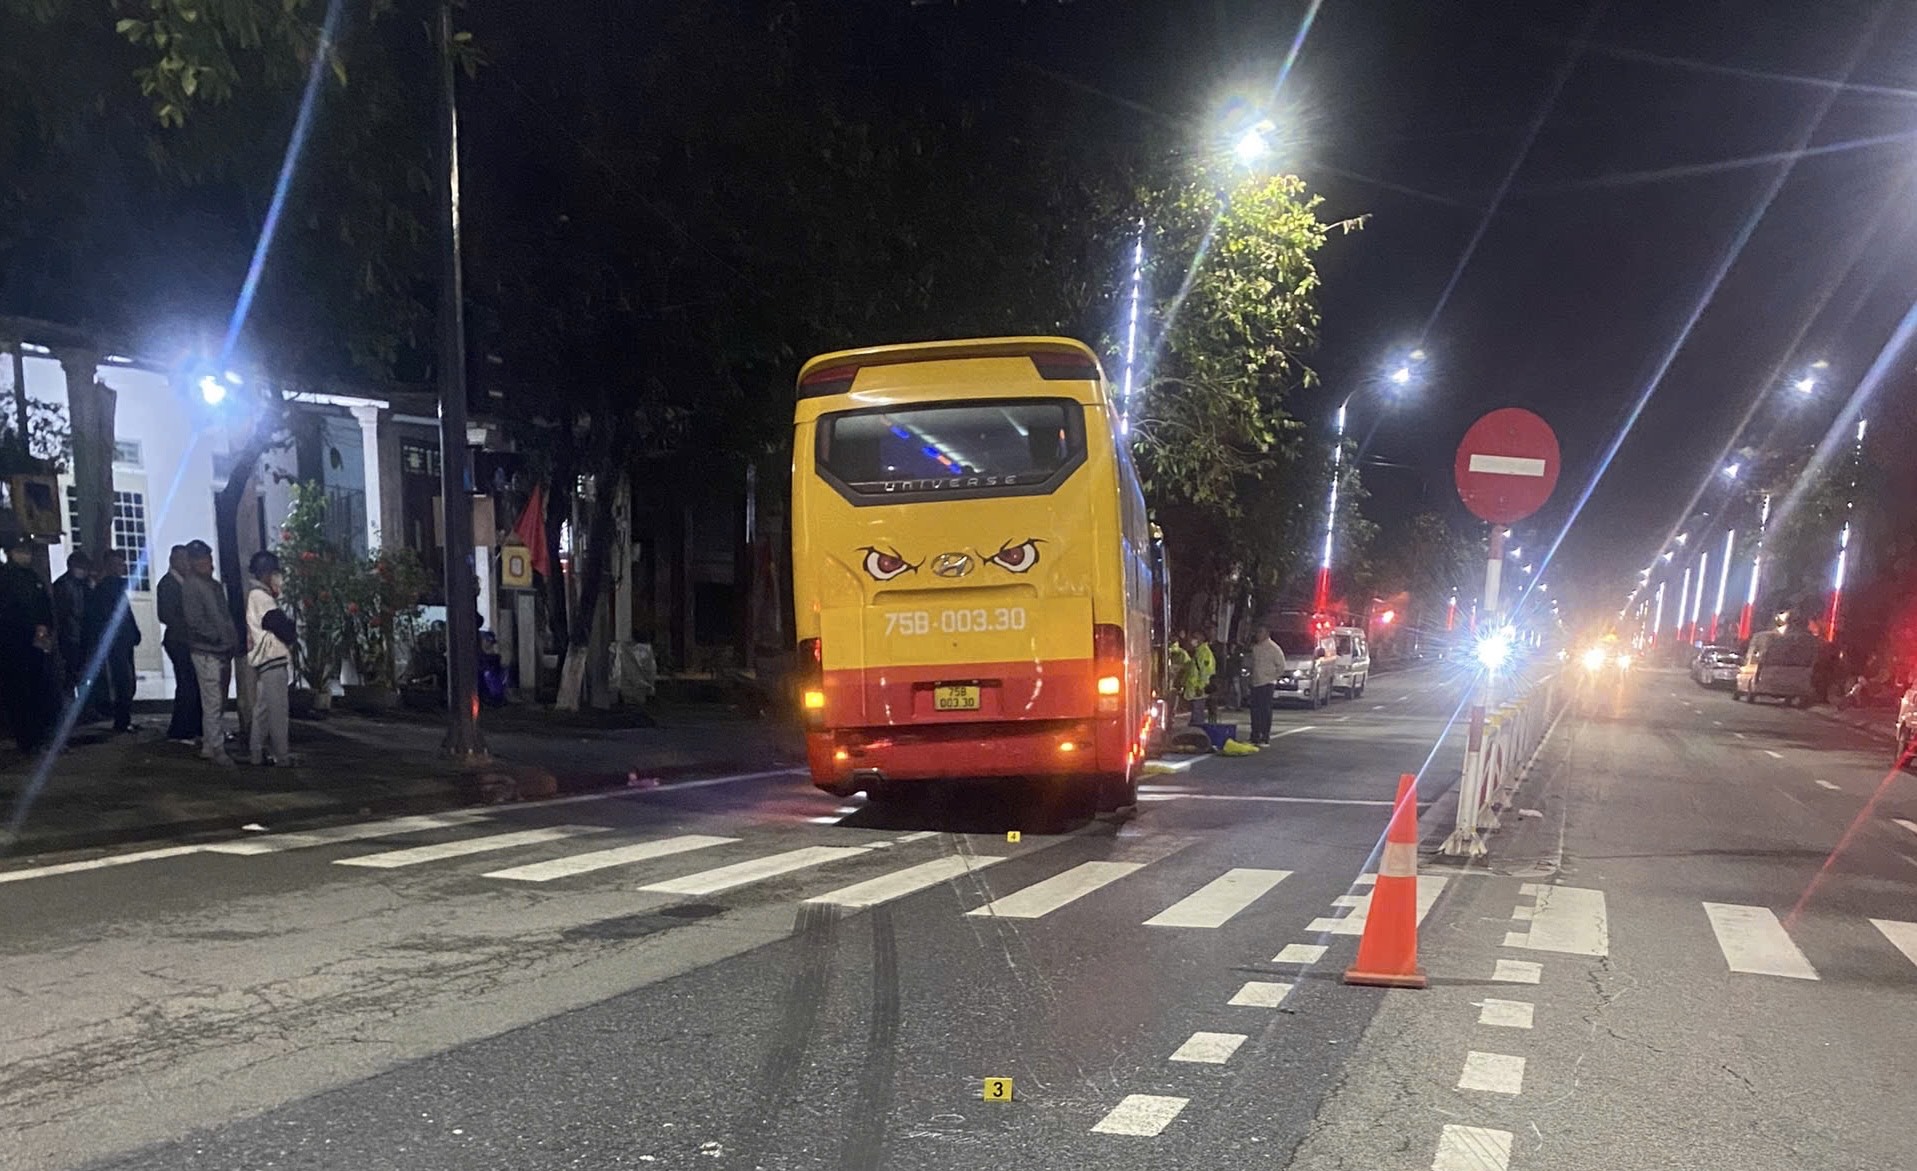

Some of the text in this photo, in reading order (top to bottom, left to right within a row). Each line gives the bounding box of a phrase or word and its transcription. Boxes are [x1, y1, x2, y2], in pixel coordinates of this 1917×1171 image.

[884, 475, 1017, 492] UNIVERSE
[948, 687, 967, 697] 75B
[993, 1081, 1003, 1098] 3
